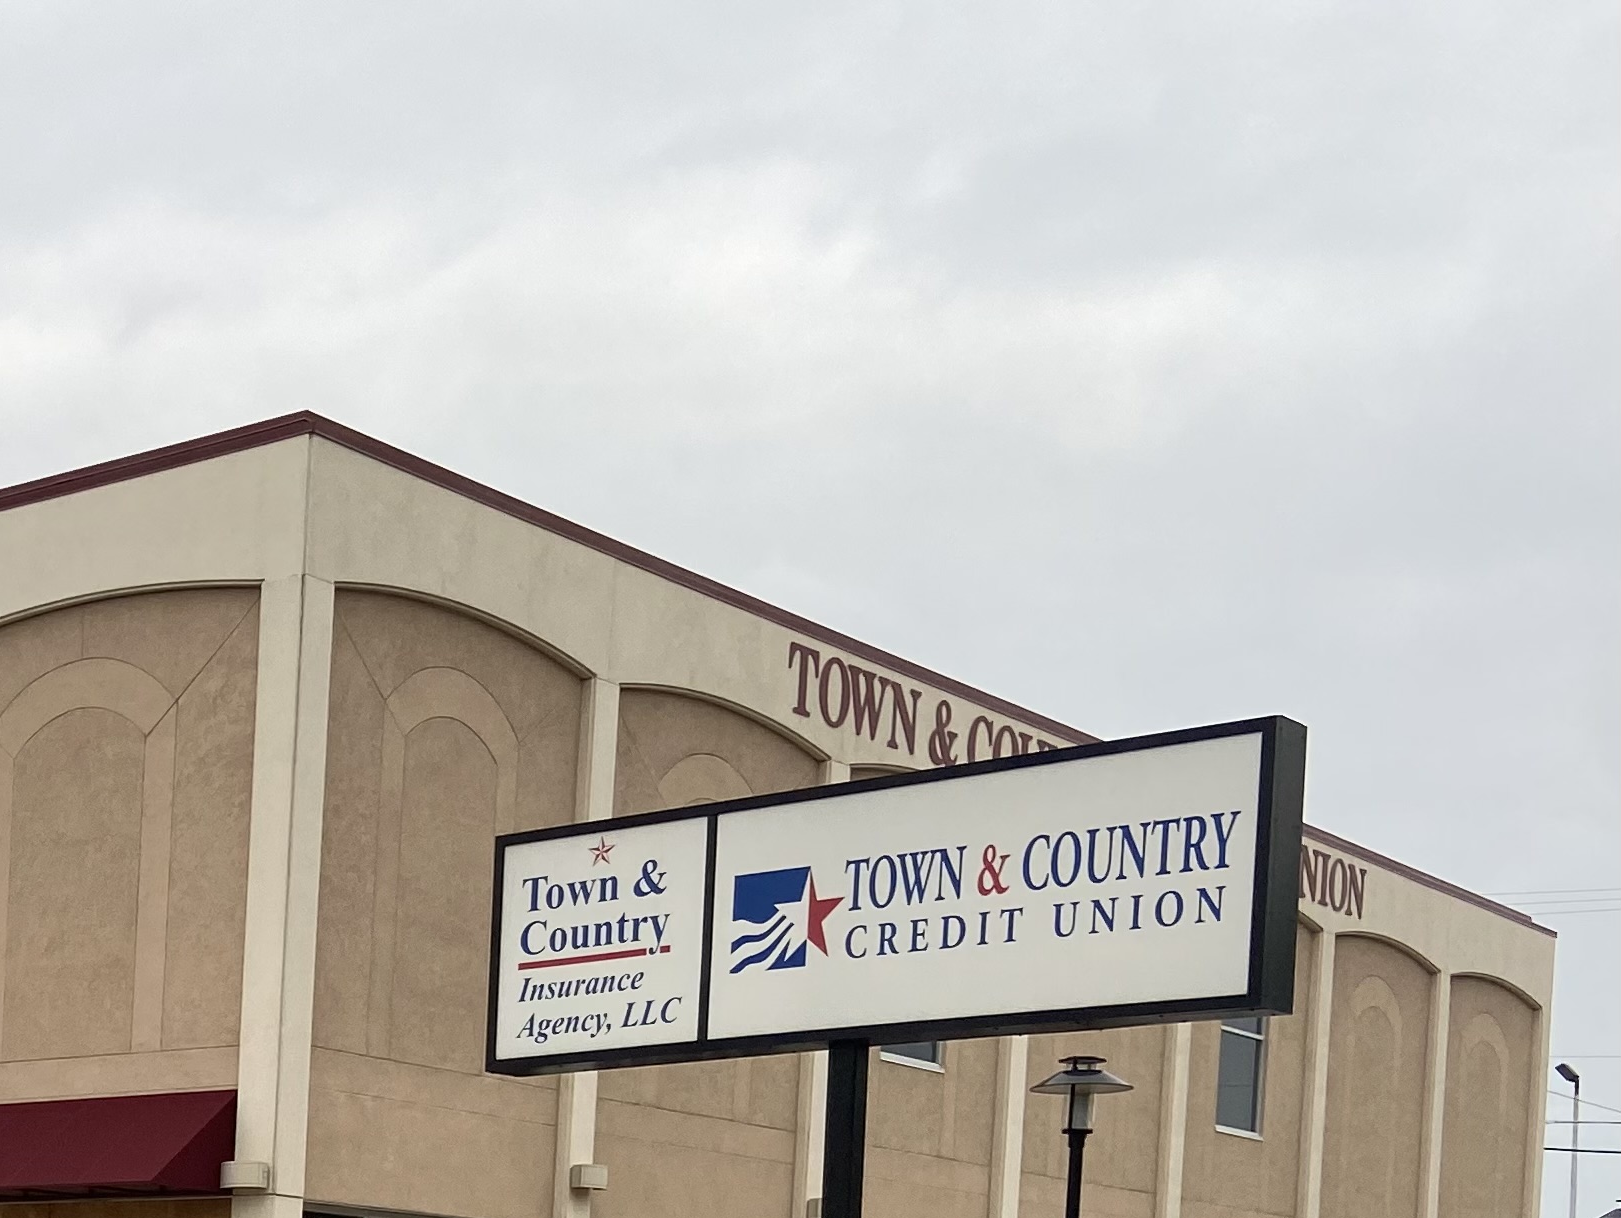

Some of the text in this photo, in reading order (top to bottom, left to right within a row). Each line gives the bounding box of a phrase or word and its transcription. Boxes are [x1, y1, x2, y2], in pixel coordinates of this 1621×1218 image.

[788, 642, 922, 755] TOWN
[928, 700, 958, 767] &
[522, 859, 667, 912] Town &
[845, 810, 1241, 911] TOWN & COUNTRY
[1299, 844, 1367, 920] NION
[520, 912, 670, 955] Country
[845, 885, 1226, 959] CREDIT UNION
[518, 971, 644, 1002] Insurance
[516, 996, 682, 1044] Agency, LLC
